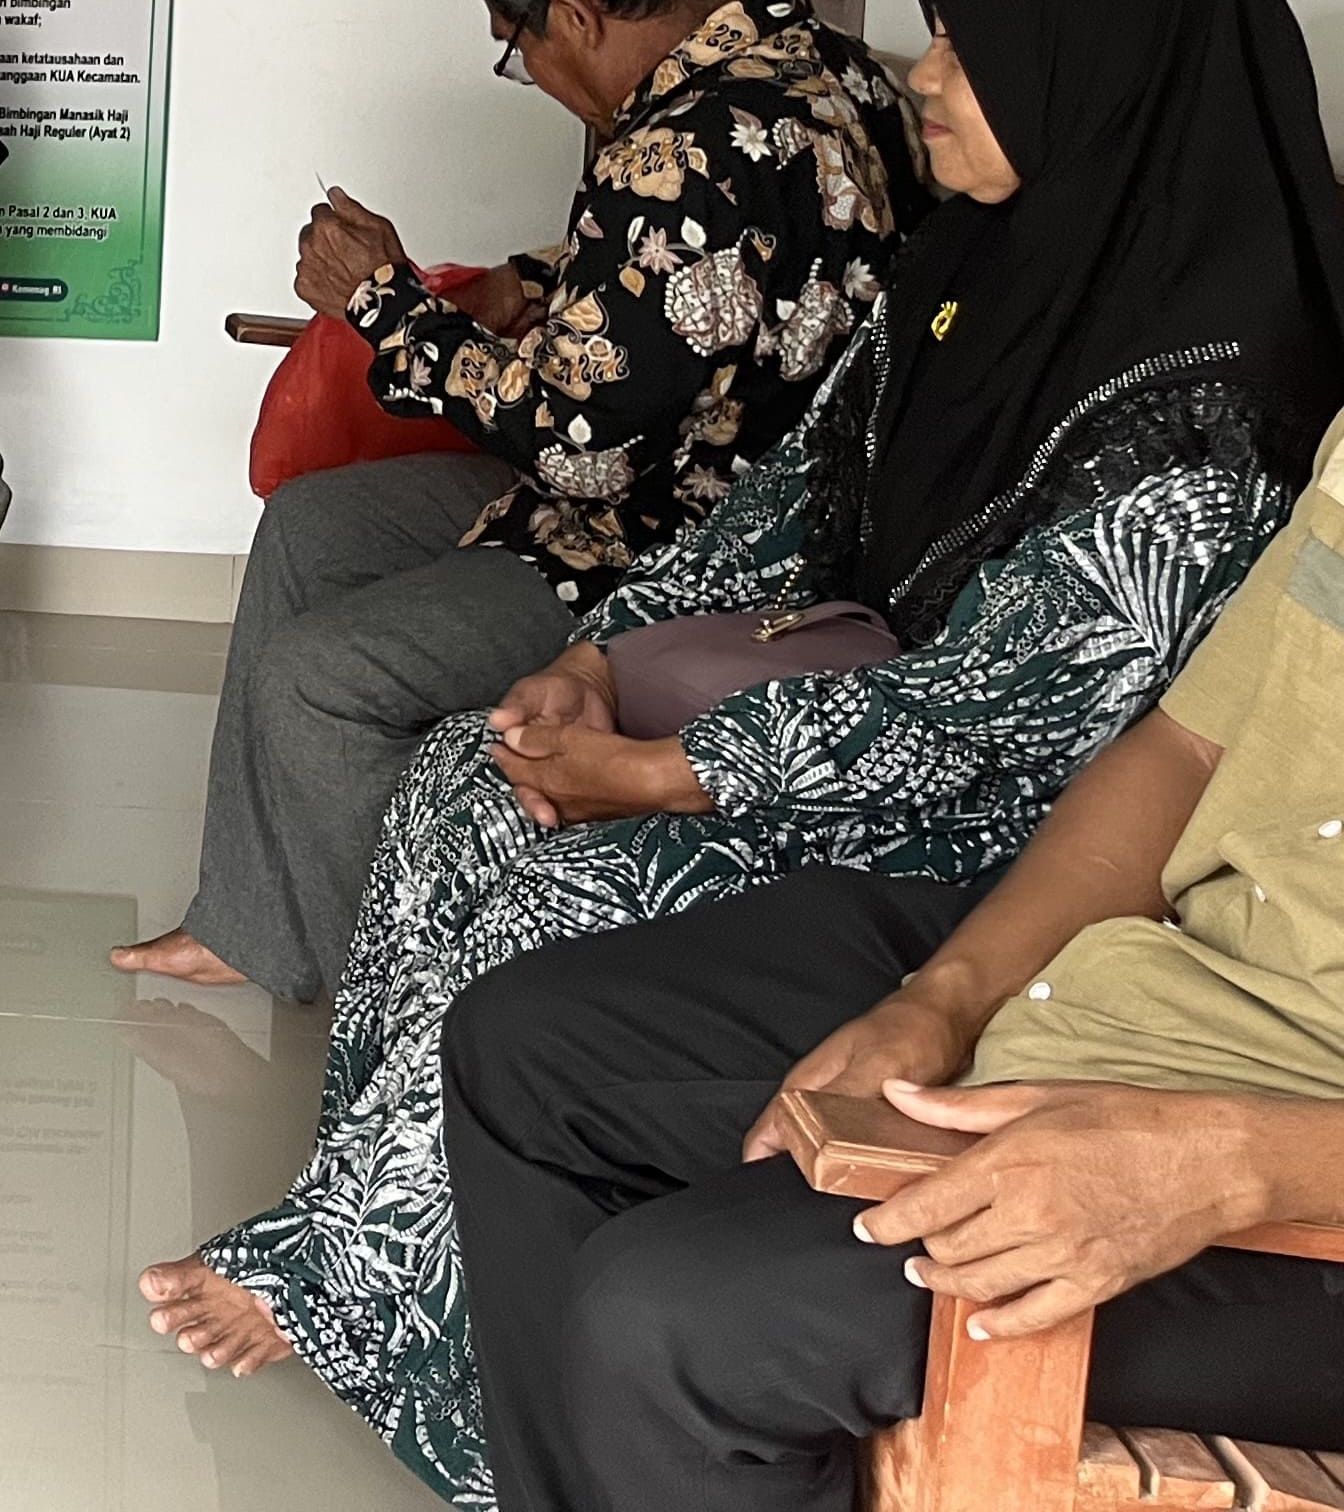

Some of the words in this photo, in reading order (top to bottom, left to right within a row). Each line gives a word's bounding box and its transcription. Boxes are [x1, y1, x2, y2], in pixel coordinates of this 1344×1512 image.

[4, 14, 43, 27] wakaf;
[21, 52, 101, 66] ketatausahaan
[103, 54, 124, 66] dan
[50, 70, 74, 82] KUA
[77, 70, 141, 84] Kecamatan.
[60, 108, 104, 121] Manasik
[107, 109, 129, 124] Haji
[20, 125, 41, 140] Haji
[43, 126, 87, 140] Reguler
[89, 126, 118, 141] (Ayat
[120, 127, 131, 141] 2)
[8, 205, 40, 218] Pasal
[43, 206, 50, 218] 2
[52, 207, 74, 218] dan
[91, 207, 117, 220] KUA
[6, 226, 34, 239] yang
[37, 225, 107, 240] membidangi
